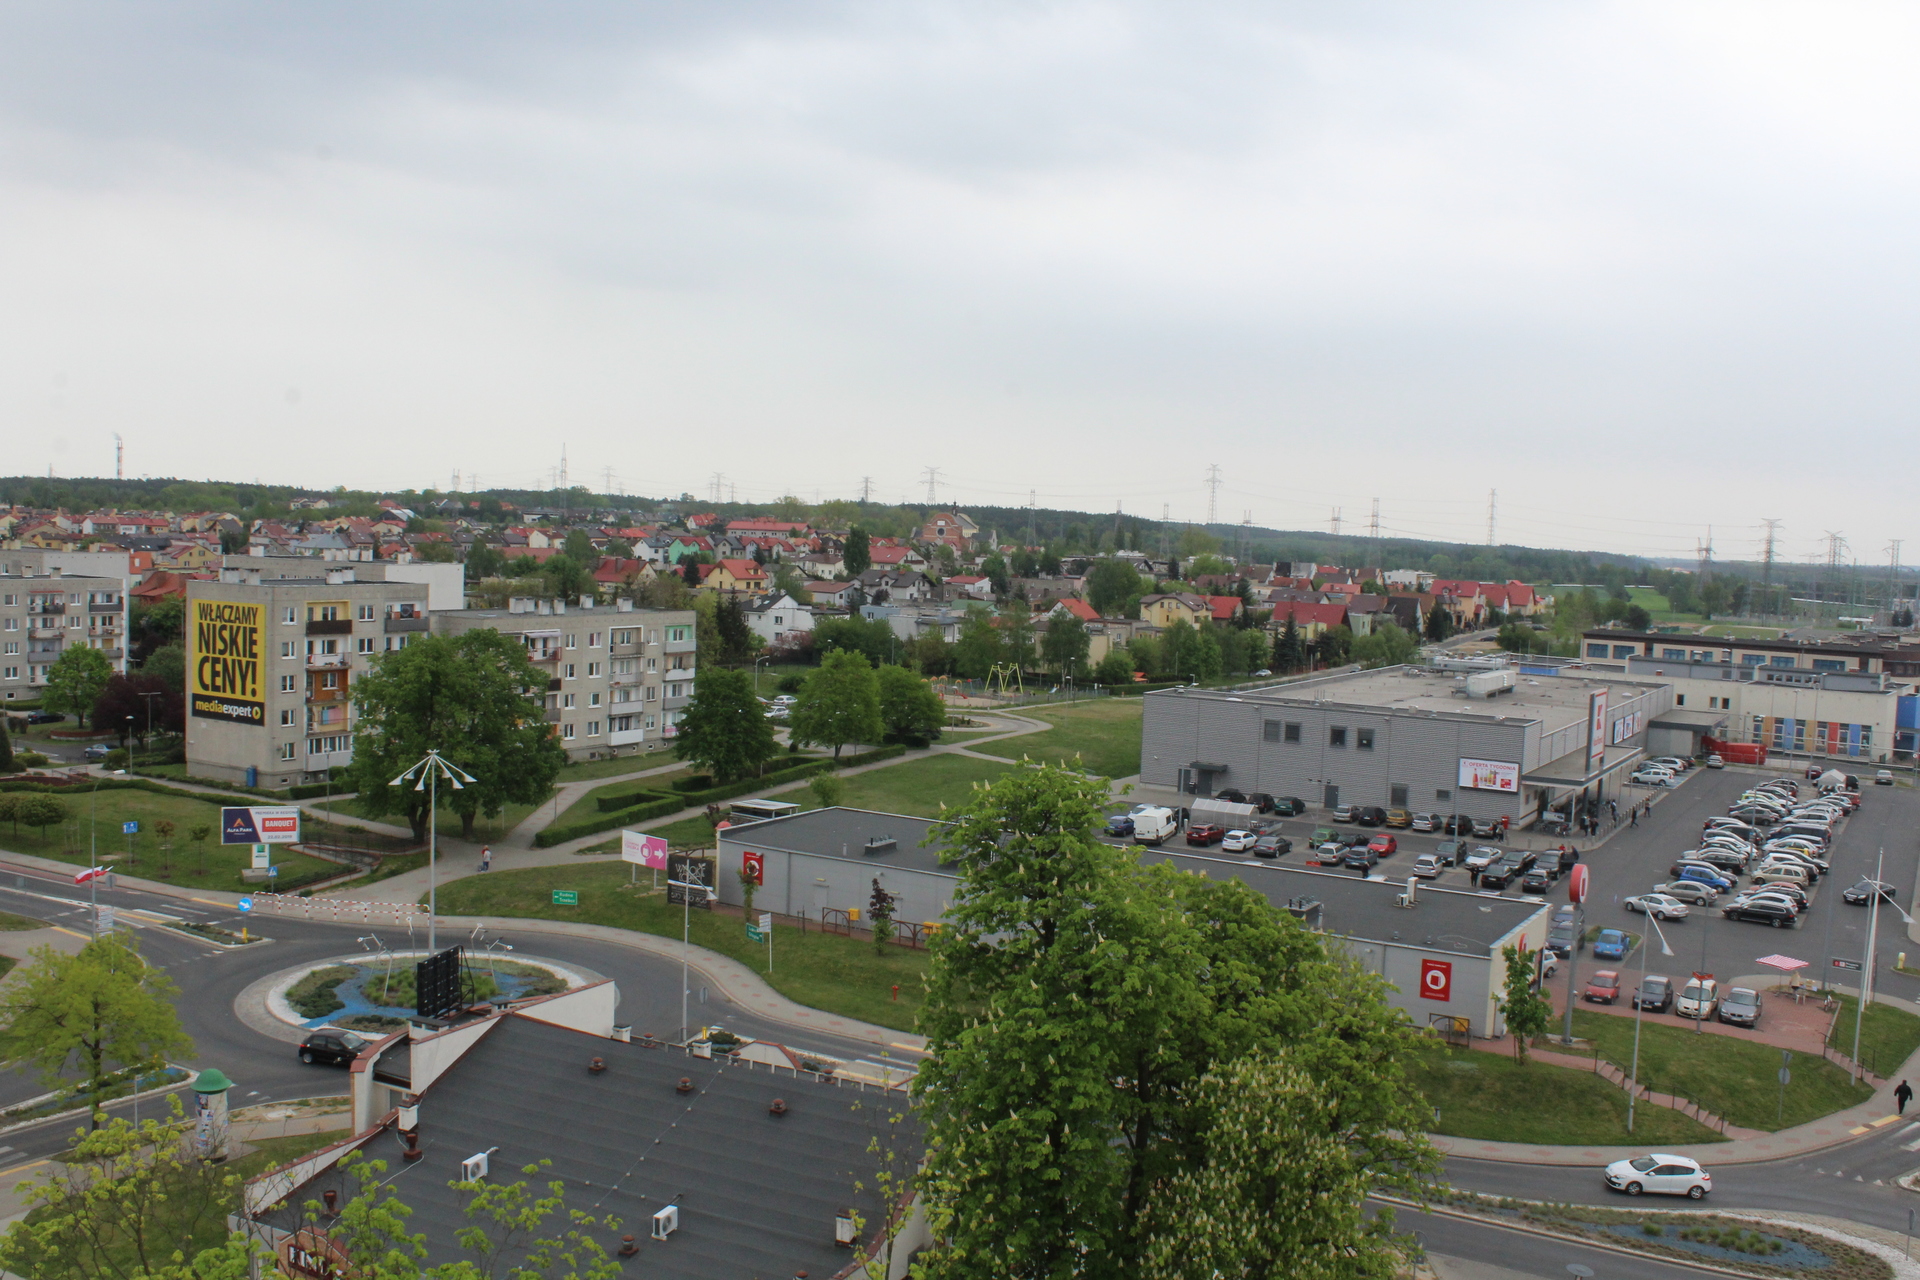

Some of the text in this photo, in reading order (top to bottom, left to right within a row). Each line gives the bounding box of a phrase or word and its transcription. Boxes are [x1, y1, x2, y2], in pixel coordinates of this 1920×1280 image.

[198, 602, 258, 626] WŁĄCZAMY
[198, 622, 258, 659] NISKIE
[198, 655, 257, 698] CENY!
[195, 700, 252, 718] mediaexpert
[265, 820, 294, 828] BANQUET
